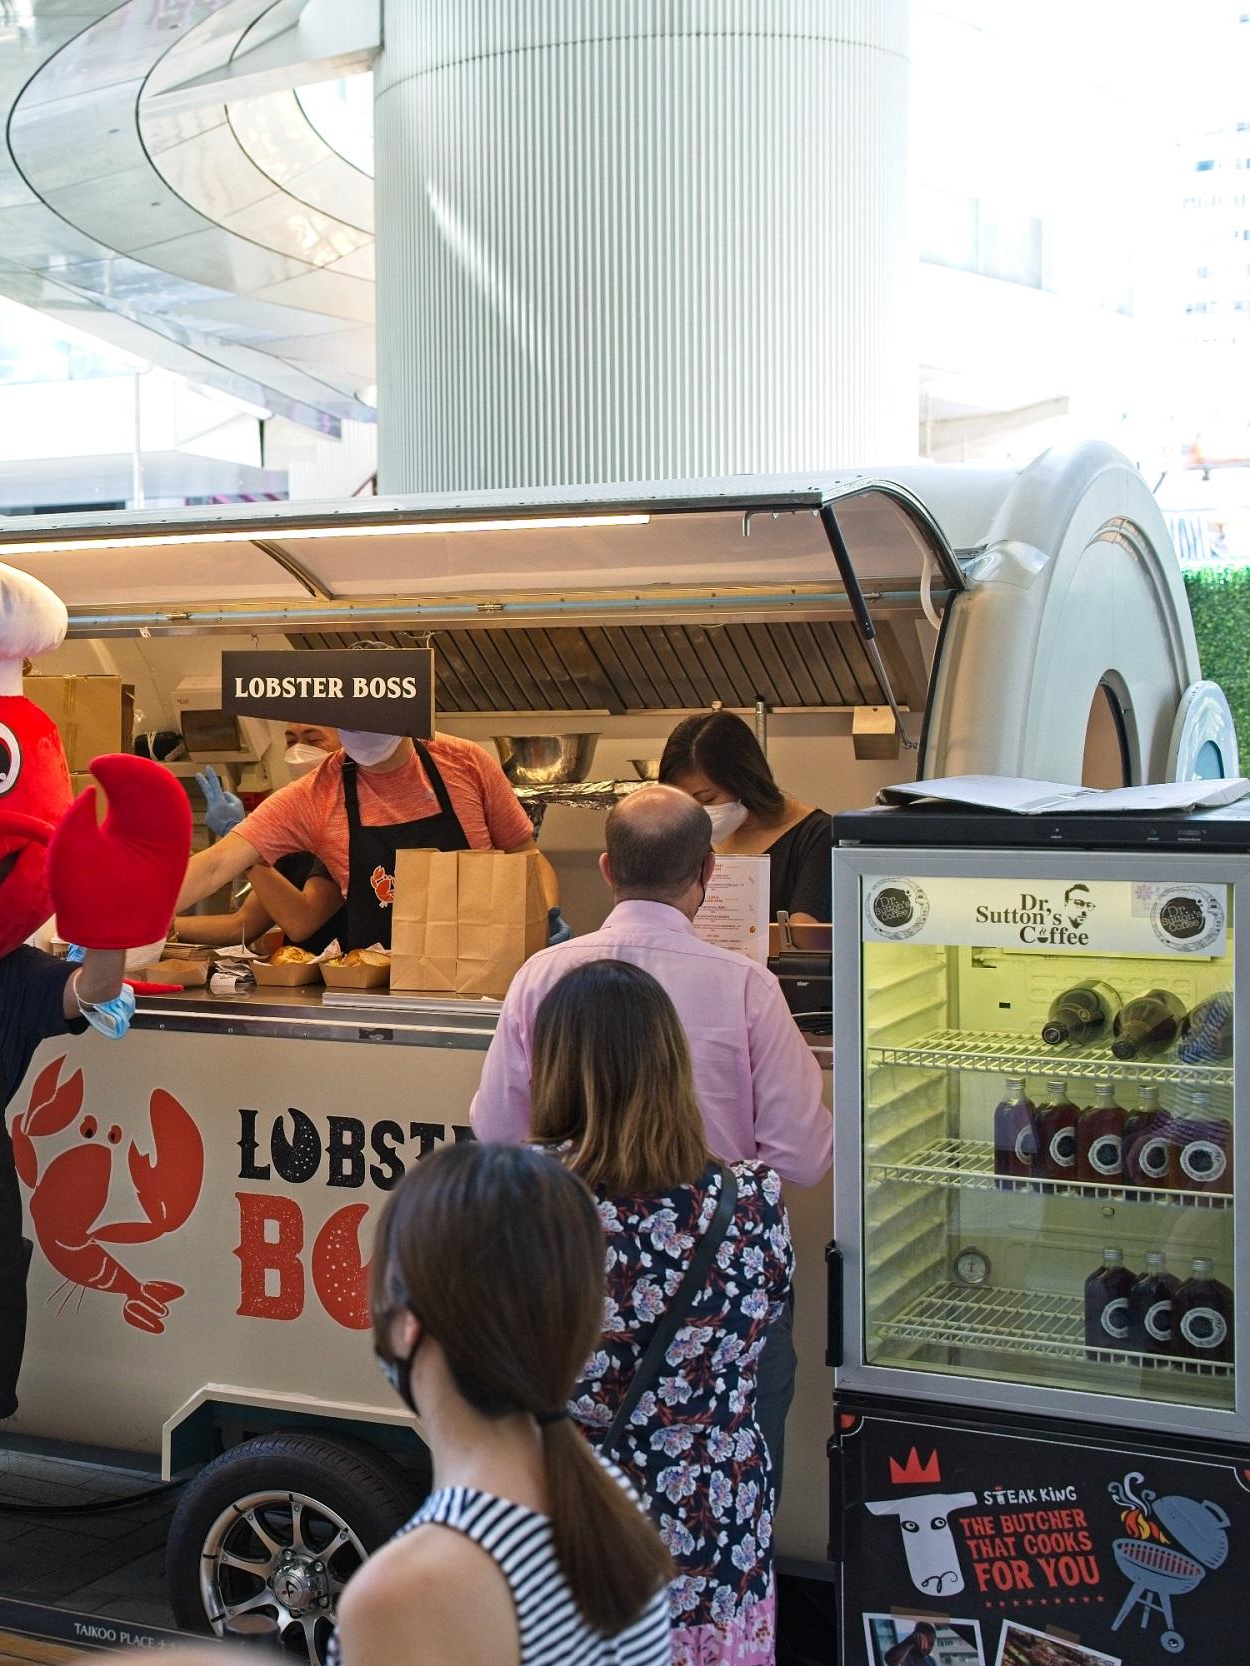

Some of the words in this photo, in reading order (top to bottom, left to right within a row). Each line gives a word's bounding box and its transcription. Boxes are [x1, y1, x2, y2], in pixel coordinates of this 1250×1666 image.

[234, 676, 344, 699] LOBSTER
[352, 676, 418, 699] BOSS
[975, 905, 1062, 926] Sutton's
[1019, 925, 1089, 945] Coffee
[236, 1107, 480, 1191] LOBST
[232, 1191, 376, 1331] BO
[983, 1488, 1038, 1506] STEAK
[959, 1515, 996, 1537] THE
[1000, 1508, 1088, 1534] BUTCHER
[966, 1536, 1017, 1560] THAT
[1023, 1530, 1093, 1555] COOKS
[974, 1559, 1035, 1593] FOR
[1037, 1555, 1101, 1588] YOU
[73, 1622, 117, 1641] TAIKOO
[119, 1631, 155, 1649] PLACE
